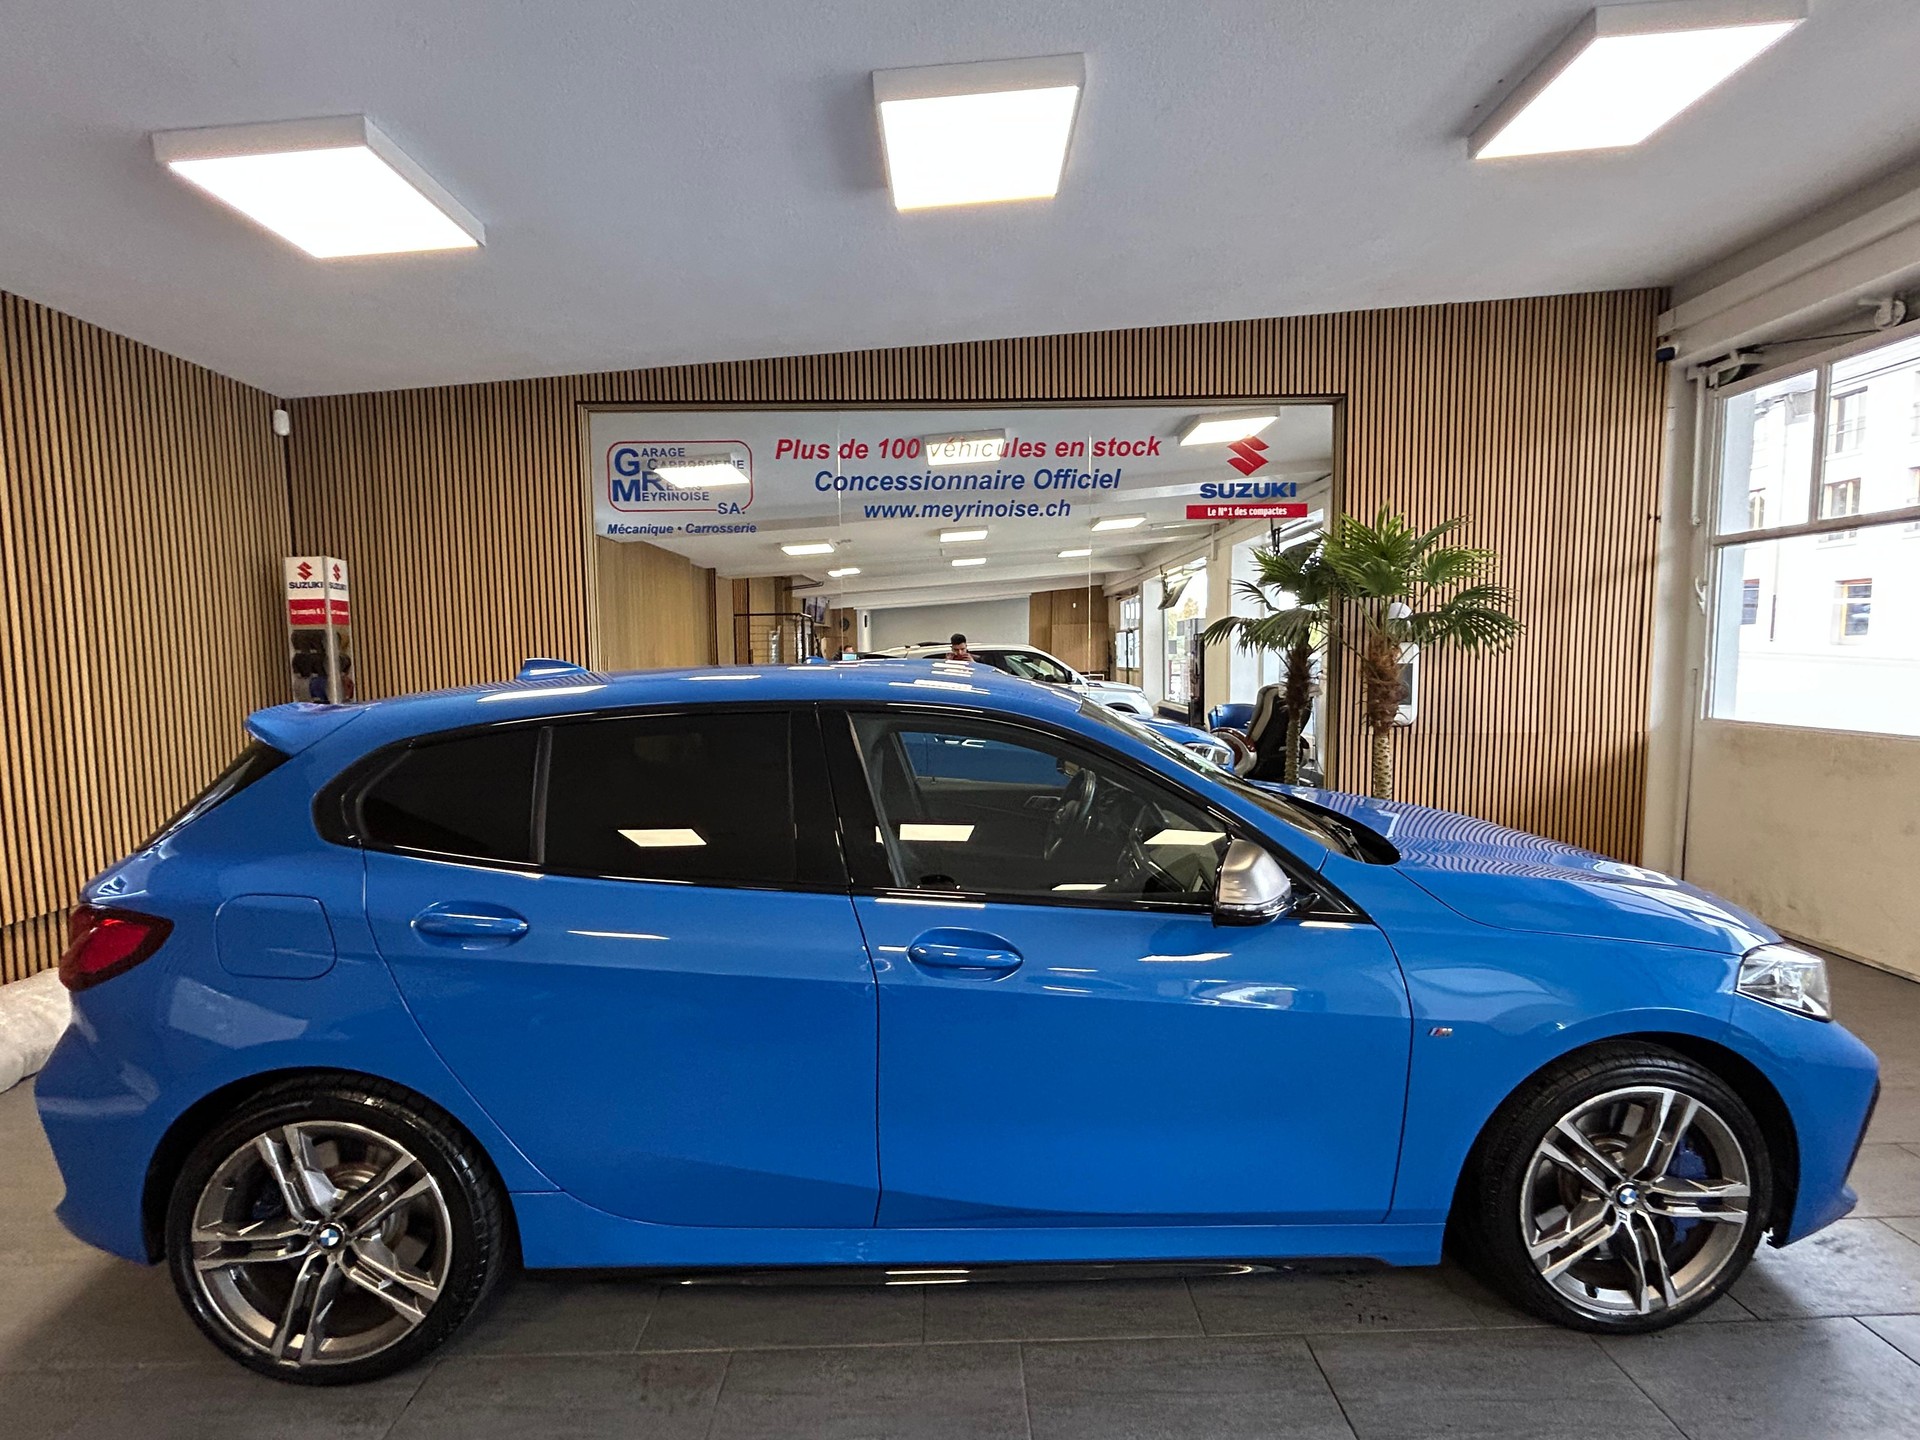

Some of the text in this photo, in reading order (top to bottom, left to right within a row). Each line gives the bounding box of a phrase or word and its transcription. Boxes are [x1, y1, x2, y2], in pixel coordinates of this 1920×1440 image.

[775, 436, 1162, 460] Plus de 100 véhicules en stock
[815, 468, 1122, 492] Concessionnaire Officiel
[1199, 481, 1297, 499] SUZUKI
[864, 498, 1071, 523] www.meyrinoise.ch
[1207, 507, 1216, 517] Le
[1234, 506, 1248, 516] des
[1248, 506, 1288, 518] compactes
[607, 522, 757, 535] Mécanique Carrosserie
[288, 581, 324, 589] SUZUKI
